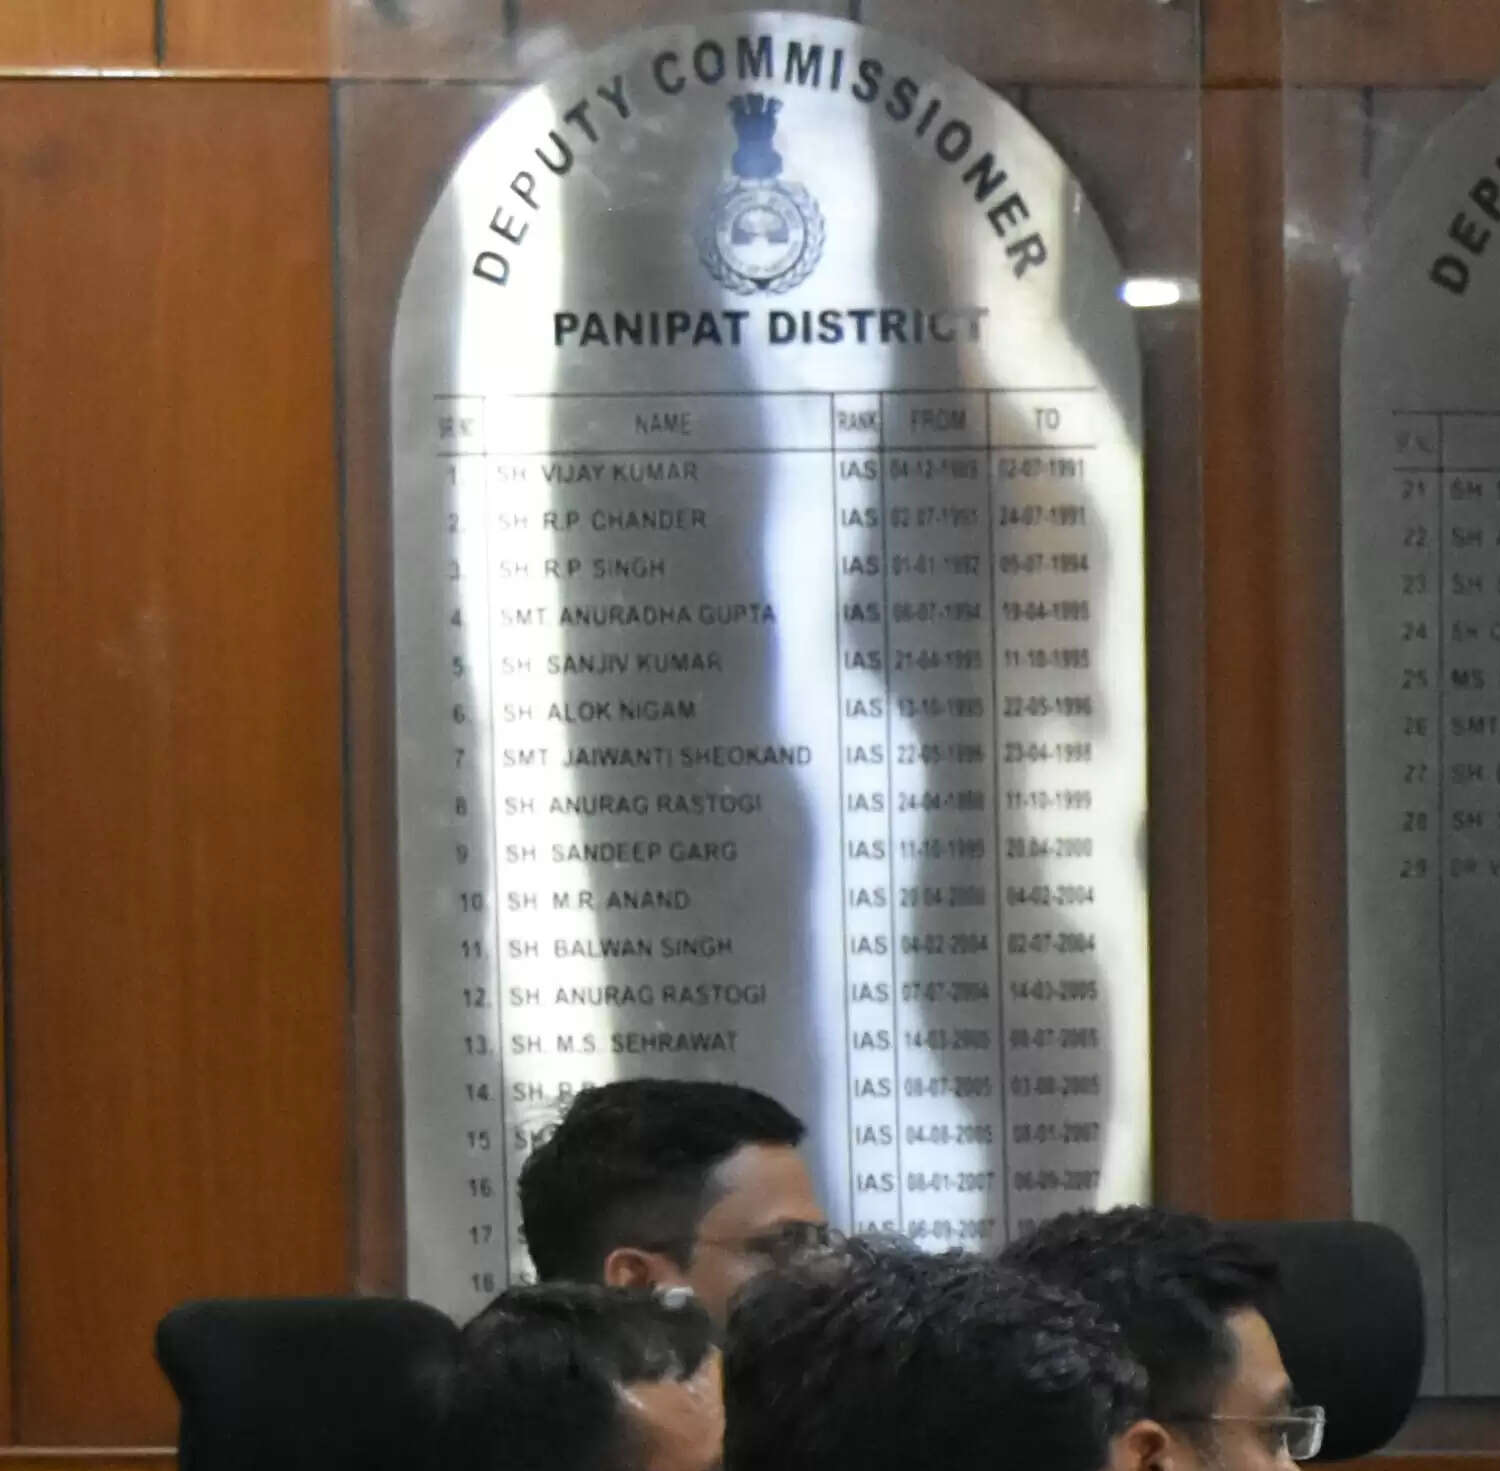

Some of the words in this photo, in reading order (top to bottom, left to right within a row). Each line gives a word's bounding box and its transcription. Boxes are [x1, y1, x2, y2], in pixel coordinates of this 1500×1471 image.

[471, 74, 634, 287] DEPUTY
[651, 35, 1048, 280] COMMISSIONER
[553, 312, 750, 350] PANIPAT
[767, 307, 991, 346] DISTRICT
[635, 412, 692, 436] NAME
[911, 410, 967, 431] FROM
[1034, 409, 1060, 430] TO
[542, 464, 605, 484] VIJAY
[613, 462, 699, 482] KUMAR
[840, 459, 877, 480] IAS
[592, 509, 706, 529] CHANDER
[841, 507, 878, 528] IAS
[592, 558, 664, 578] SINGH
[843, 555, 879, 575] IAS
[560, 606, 692, 626] ANURADHA
[699, 604, 775, 625] GUPTA
[845, 602, 880, 622] IAS
[547, 654, 628, 674] SANJIV
[637, 653, 723, 673] KUMAR
[845, 650, 881, 671] IAS
[548, 702, 611, 722] ALOK
[620, 700, 695, 721] NIGAM
[846, 698, 882, 718] IAS
[563, 747, 671, 769] JAIWANTI
[681, 745, 812, 766] SHEOKAND
[847, 745, 883, 765] IAS
[549, 795, 648, 815] ANURAG
[656, 793, 761, 814] RASTOGI
[848, 792, 884, 812] IAS
[552, 843, 661, 863] SANDEEP
[669, 841, 738, 862] GARG
[849, 840, 885, 860] IAS
[607, 889, 691, 910] ANAND
[850, 887, 886, 907] IAS
[554, 939, 652, 959] BALWAN
[661, 937, 733, 958] SINGH
[851, 935, 887, 955] IAS
[555, 986, 653, 1006] ANURAG
[662, 984, 766, 1006] RASTOGI
[852, 983, 889, 1003] IAS
[612, 1031, 737, 1054] SEHRAWAT
[853, 1030, 890, 1050] IAS
[855, 1077, 891, 1097] IAS
[856, 1125, 892, 1145] IAS
[858, 1172, 894, 1192] IAS
